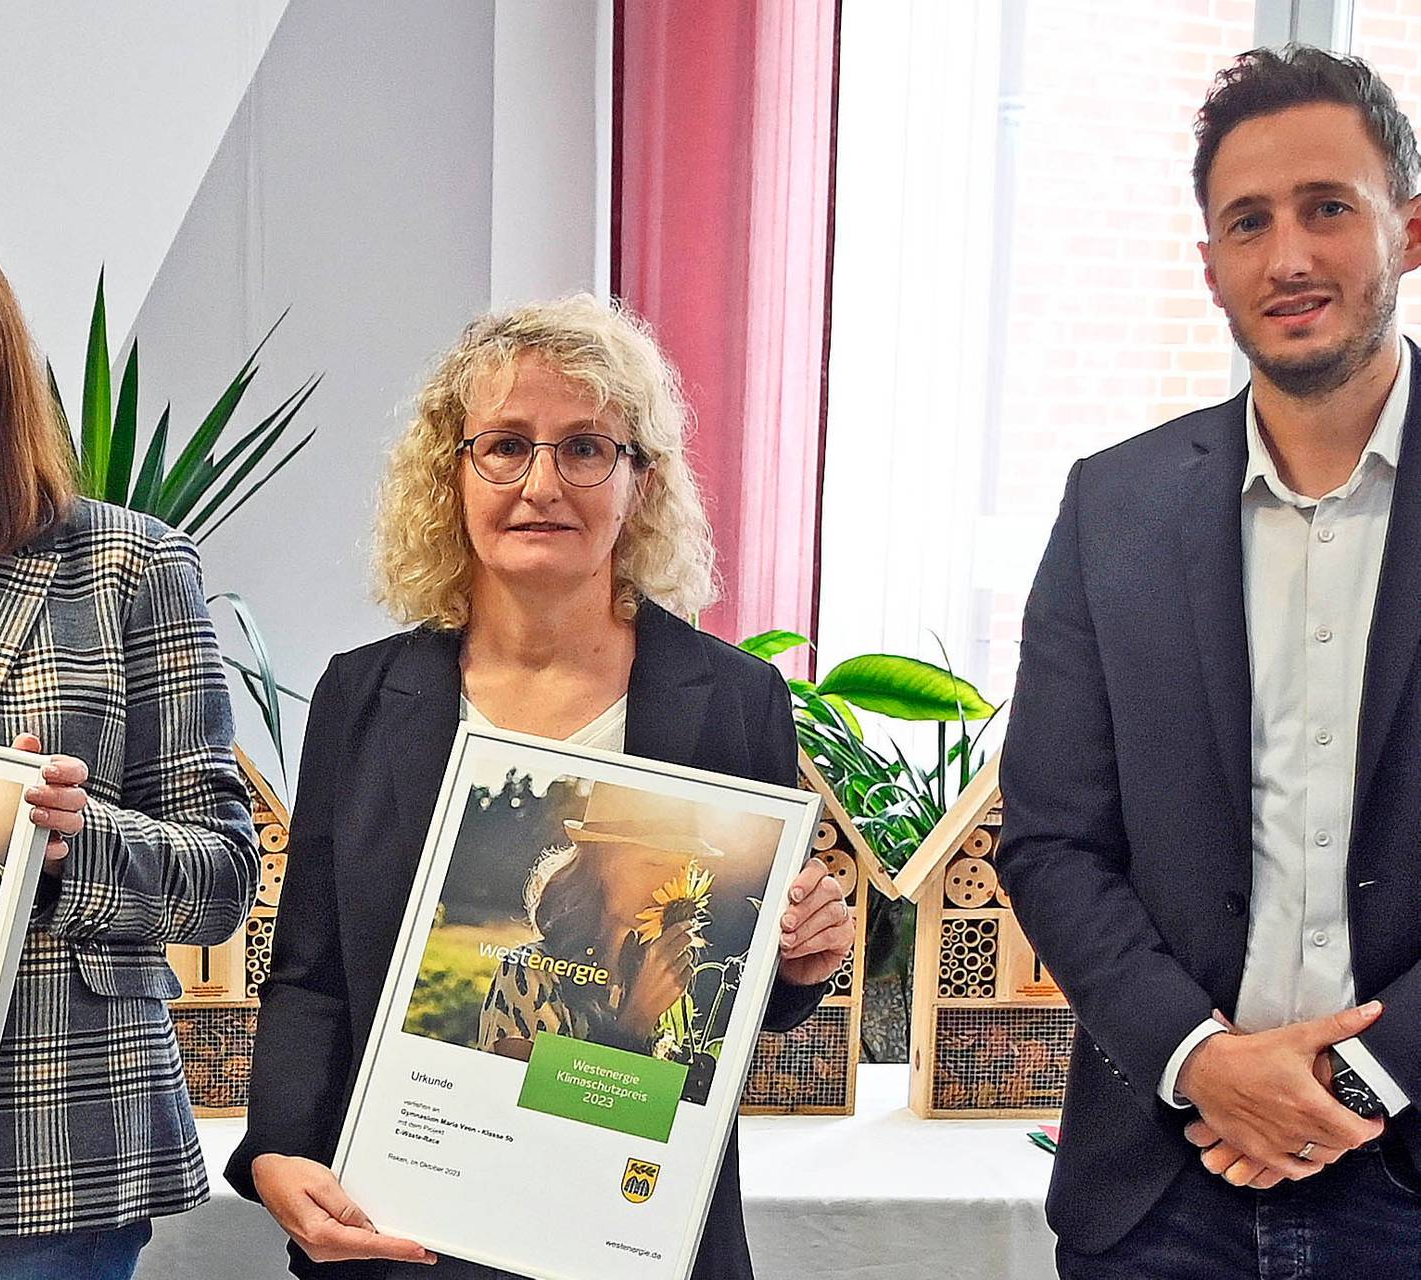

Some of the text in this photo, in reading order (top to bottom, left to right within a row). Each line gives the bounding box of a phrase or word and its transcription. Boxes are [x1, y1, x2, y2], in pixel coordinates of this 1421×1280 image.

[479, 941, 609, 986] westenergie
[410, 1070, 454, 1090] Urkunde
[573, 1058, 640, 1085] Westenergie
[556, 1070, 648, 1102] Klimaschutzpreis
[582, 1091, 614, 1108] 2023
[440, 1118, 458, 1129] Maria
[481, 1129, 504, 1139] Klasse
[605, 1241, 662, 1260] westenergie.de
